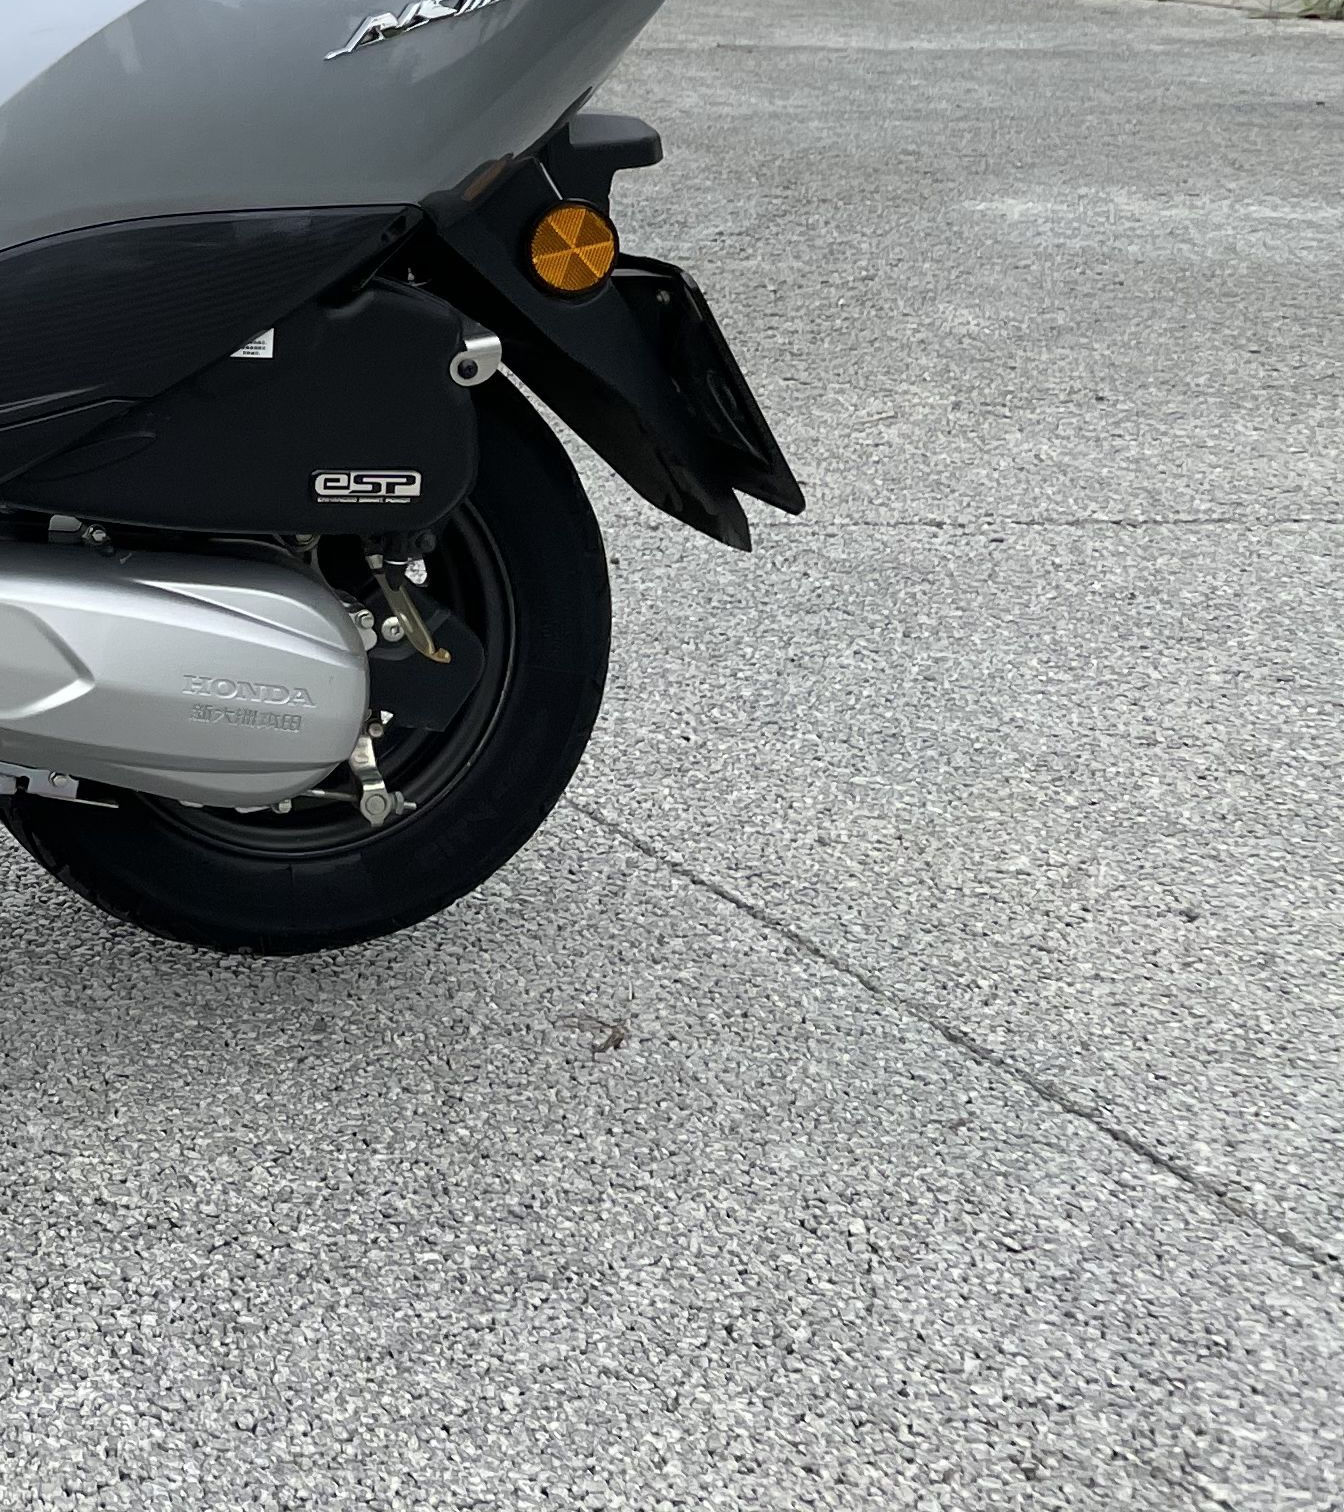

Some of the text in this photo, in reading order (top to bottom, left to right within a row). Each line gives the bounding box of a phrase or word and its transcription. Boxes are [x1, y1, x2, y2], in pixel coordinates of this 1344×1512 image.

[181, 674, 317, 709] HONDA
[190, 702, 302, 733] 新大洲本田
